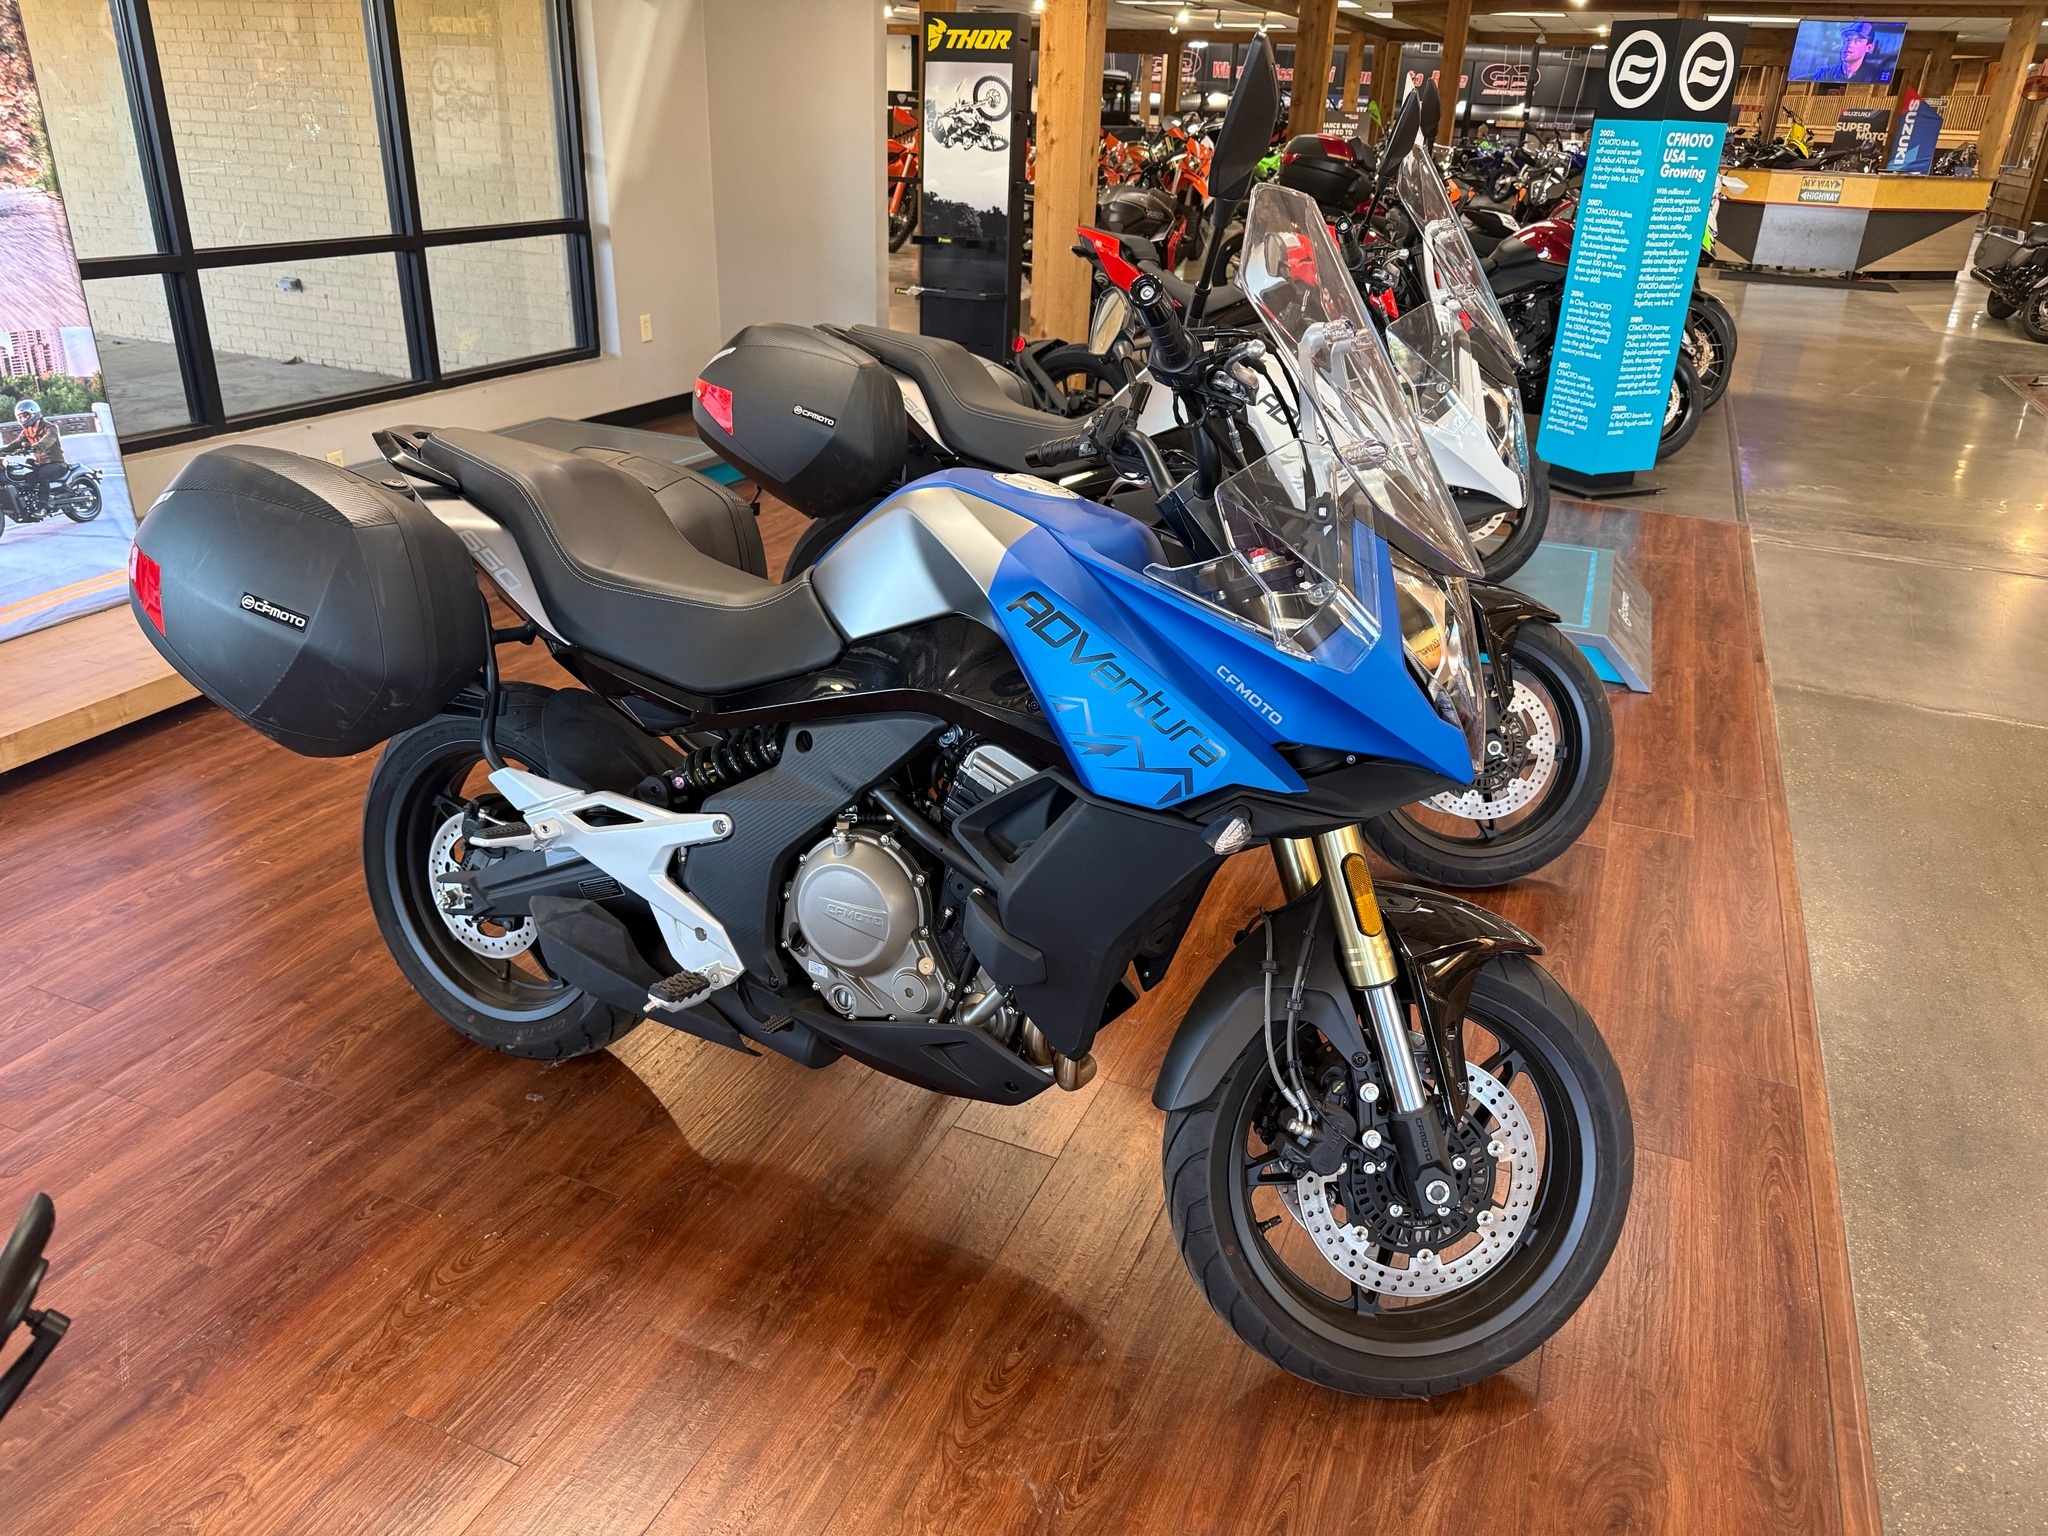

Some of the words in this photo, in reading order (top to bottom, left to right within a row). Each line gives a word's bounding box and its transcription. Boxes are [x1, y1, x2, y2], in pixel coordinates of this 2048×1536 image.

[946, 29, 1012, 49] THOR
[1835, 122, 1871, 133] SUPER
[1894, 99, 1920, 165] SUZUKI
[1666, 132, 1714, 148] CFMOTO
[1856, 131, 1886, 141] MOTO
[1663, 149, 1686, 163] USA
[1626, 167, 1644, 176] making
[1660, 164, 1706, 183] Growing
[1803, 179, 1816, 188] MY
[1818, 180, 1835, 189] WAY
[1806, 192, 1840, 201] HIGHWAY
[1586, 207, 1608, 215] CFMOTO
[1588, 225, 1620, 234] headquarters
[1595, 218, 1623, 228] establishing
[1590, 302, 1612, 311] CFMOTO
[1557, 369, 1578, 379] CFMOTO
[802, 410, 834, 426] CFMOTO
[459, 529, 523, 593] 650
[254, 600, 306, 628] CFMOTO
[1006, 590, 1227, 768] ADVentura
[1216, 664, 1283, 725] CFMOTO
[827, 903, 884, 926] CFMOTO
[1416, 1117, 1432, 1160] CFMOTO
